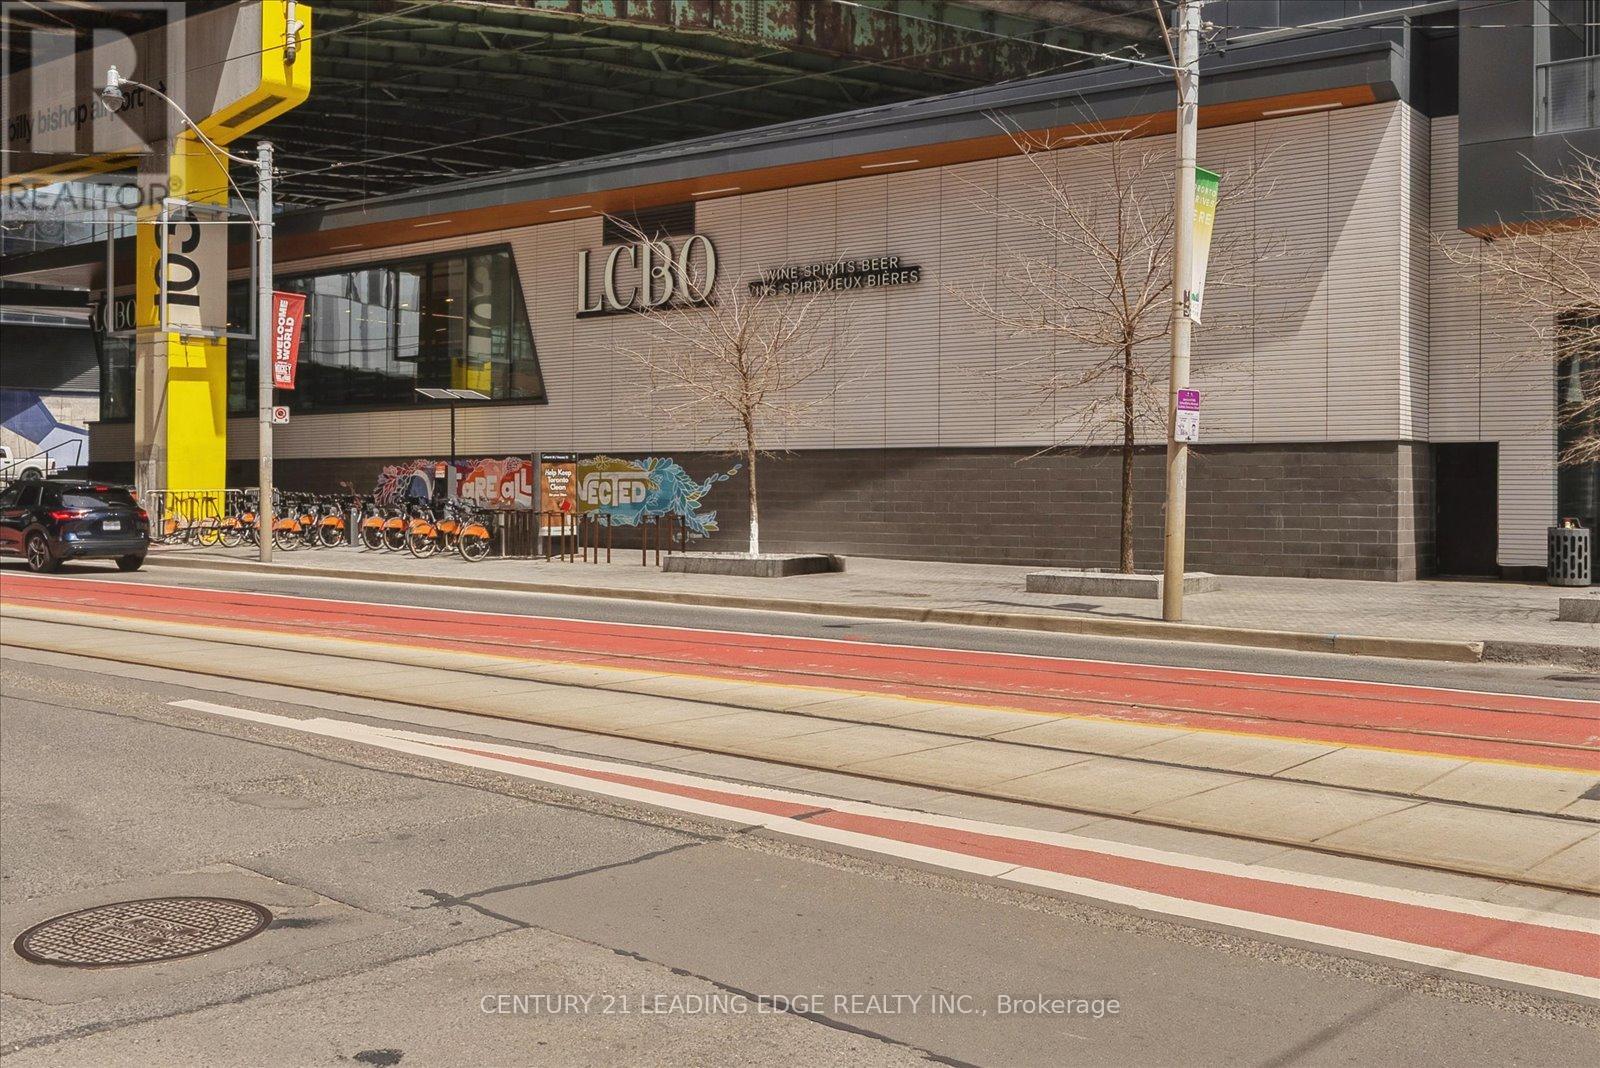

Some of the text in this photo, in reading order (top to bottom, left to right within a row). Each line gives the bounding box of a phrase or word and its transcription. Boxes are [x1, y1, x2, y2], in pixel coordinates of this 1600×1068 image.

[9, 113, 35, 143] billy
[38, 103, 88, 134] bishop
[154, 207, 201, 321] 103
[578, 234, 716, 313] LCBO
[766, 256, 898, 281] WINE SPIRITS BEER
[782, 277, 862, 295] SPIRITUEUX
[867, 270, 919, 287] BIÈRES
[276, 299, 289, 360] WELCOME
[282, 317, 295, 361] WORLD
[550, 483, 567, 491] Clean
[558, 469, 572, 478] Keep
